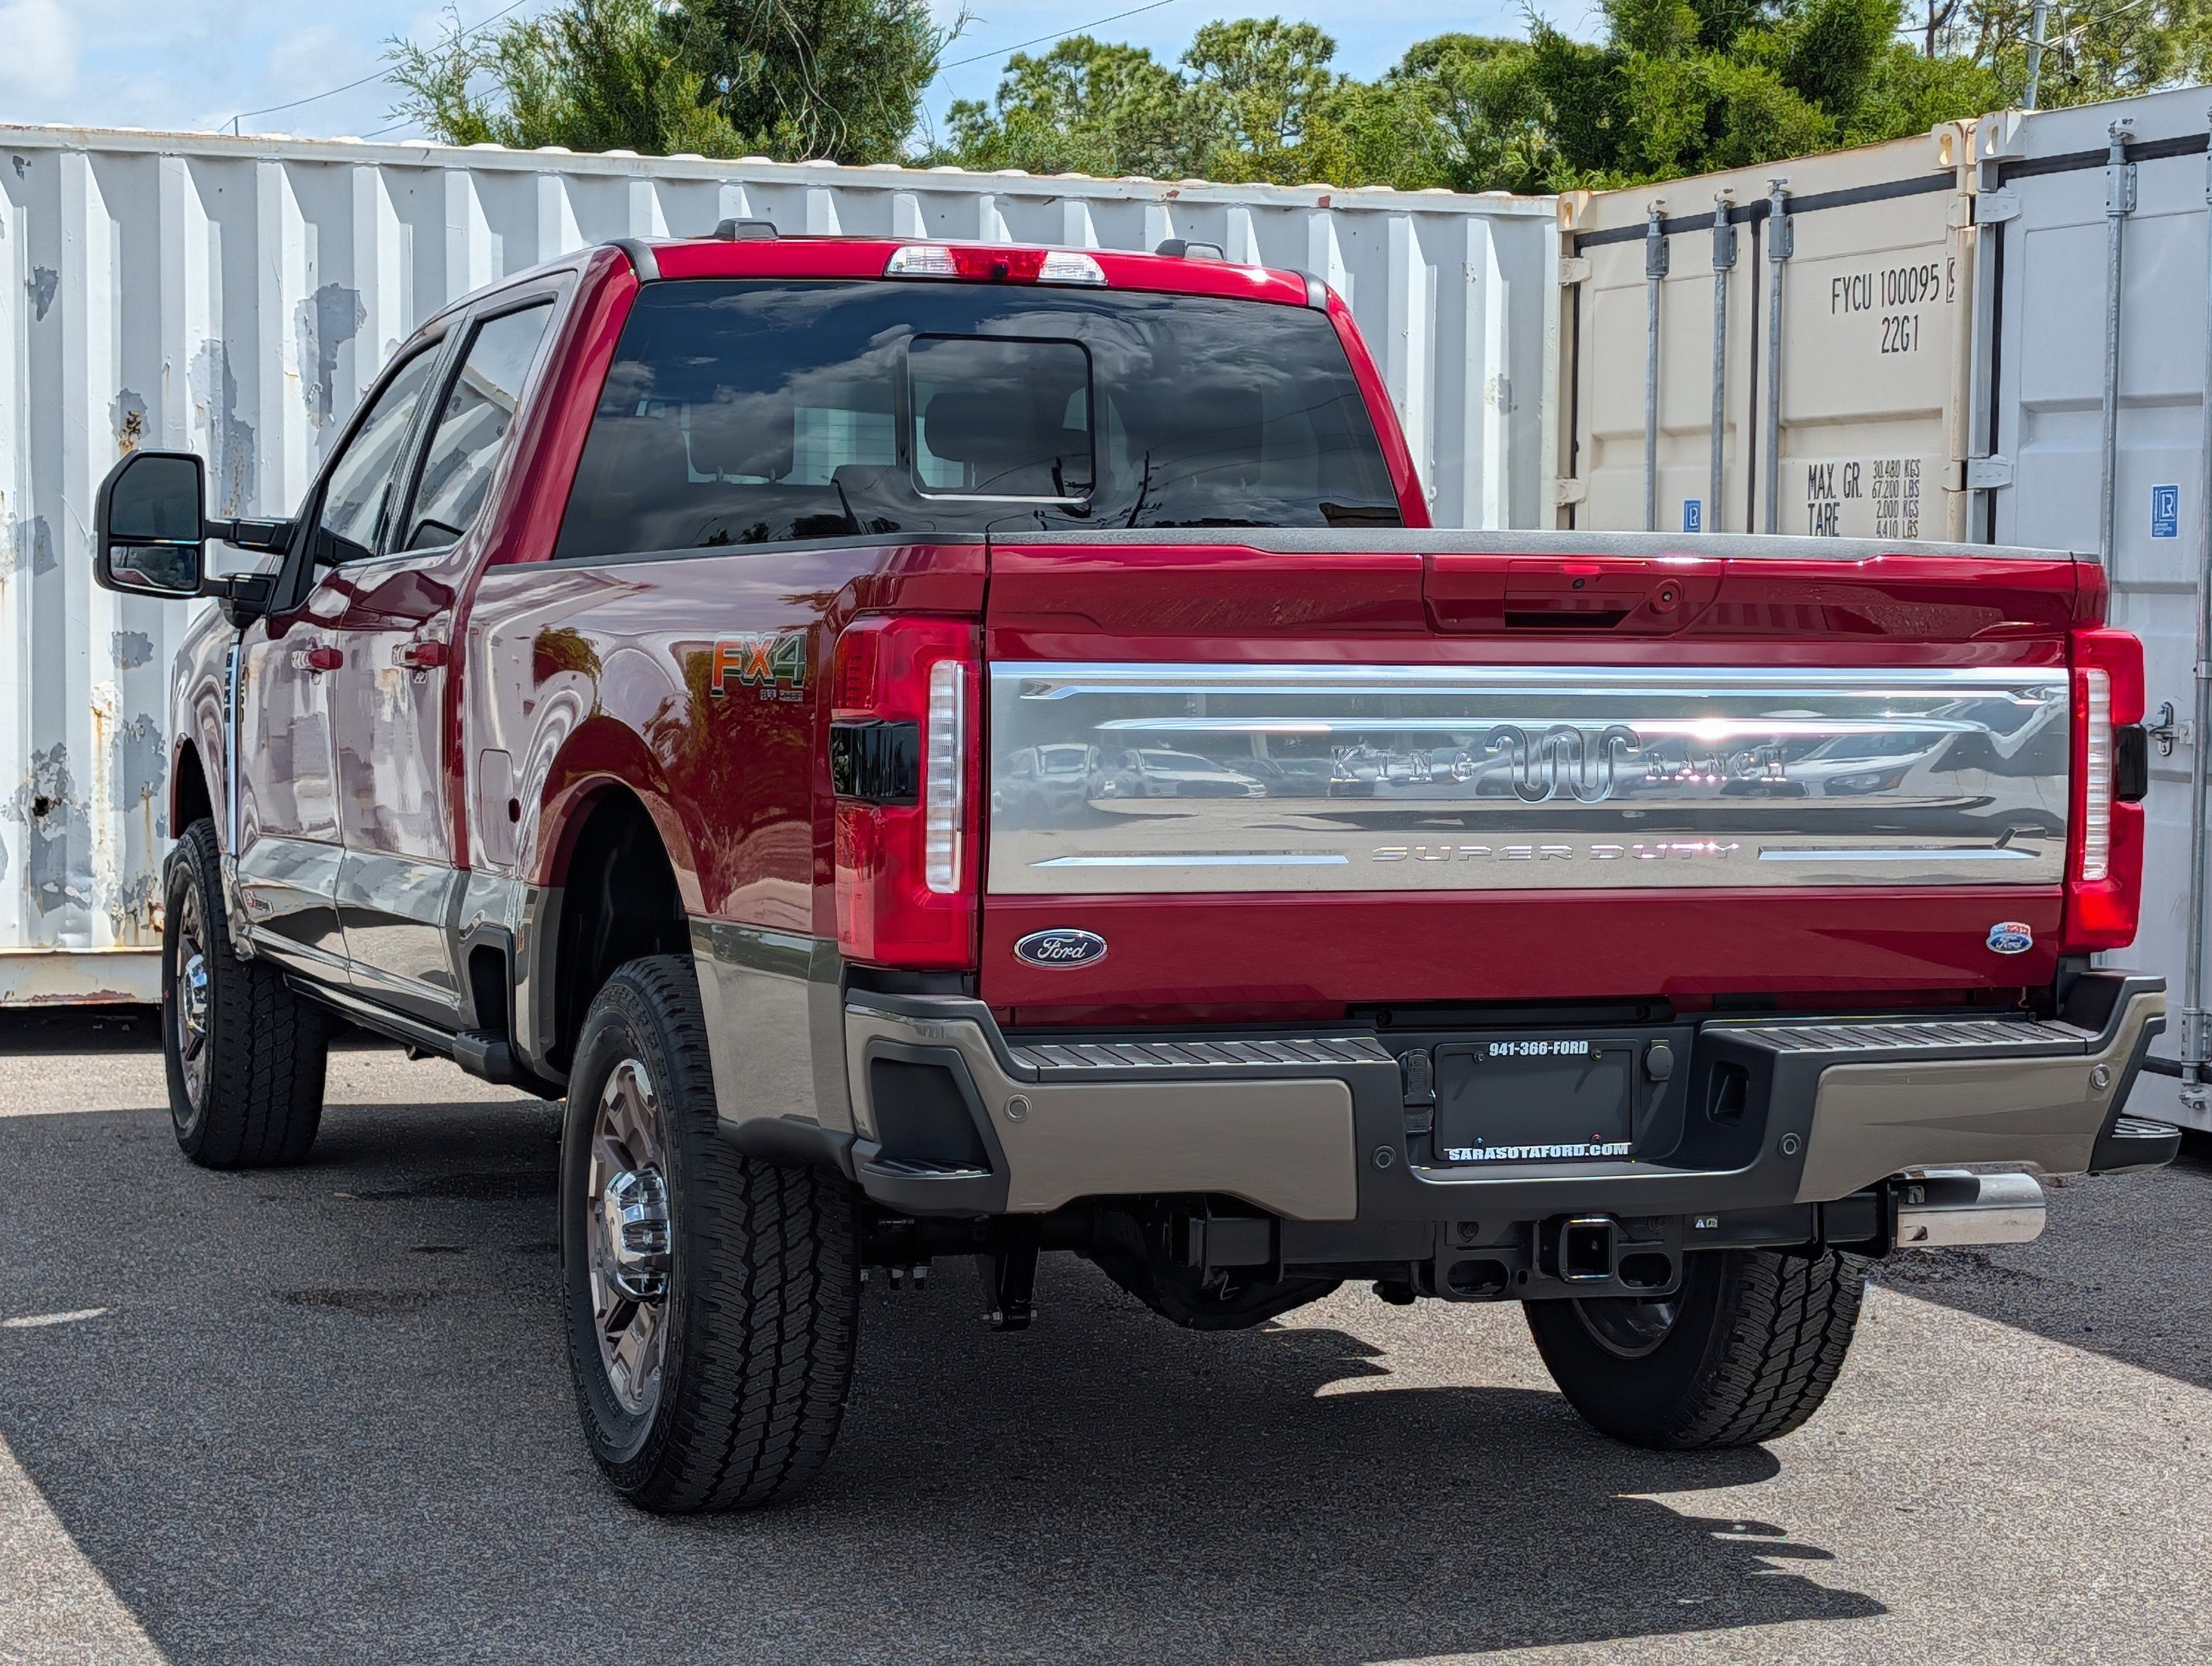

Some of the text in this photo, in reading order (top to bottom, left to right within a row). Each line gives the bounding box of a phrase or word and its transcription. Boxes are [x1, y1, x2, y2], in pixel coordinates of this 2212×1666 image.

[1832, 272, 1872, 315] FYCU
[1881, 263, 1940, 307] 100095
[1881, 314, 1919, 354] 22G1
[1904, 459, 1921, 478] KGS
[1903, 479, 1920, 498] LBS
[1808, 502, 1840, 537] TARE
[1902, 499, 1919, 518] KGS
[1902, 519, 1919, 539] LBS
[710, 630, 808, 697] FX4
[1330, 745, 1788, 783] KING RANCH
[1372, 842, 1739, 862] SUPER DUTY
[1037, 937, 1089, 959] Ford
[1489, 1041, 1589, 1056] 941-366-FORD
[1449, 1144, 1628, 1161] SARASOTAFORD.COM
